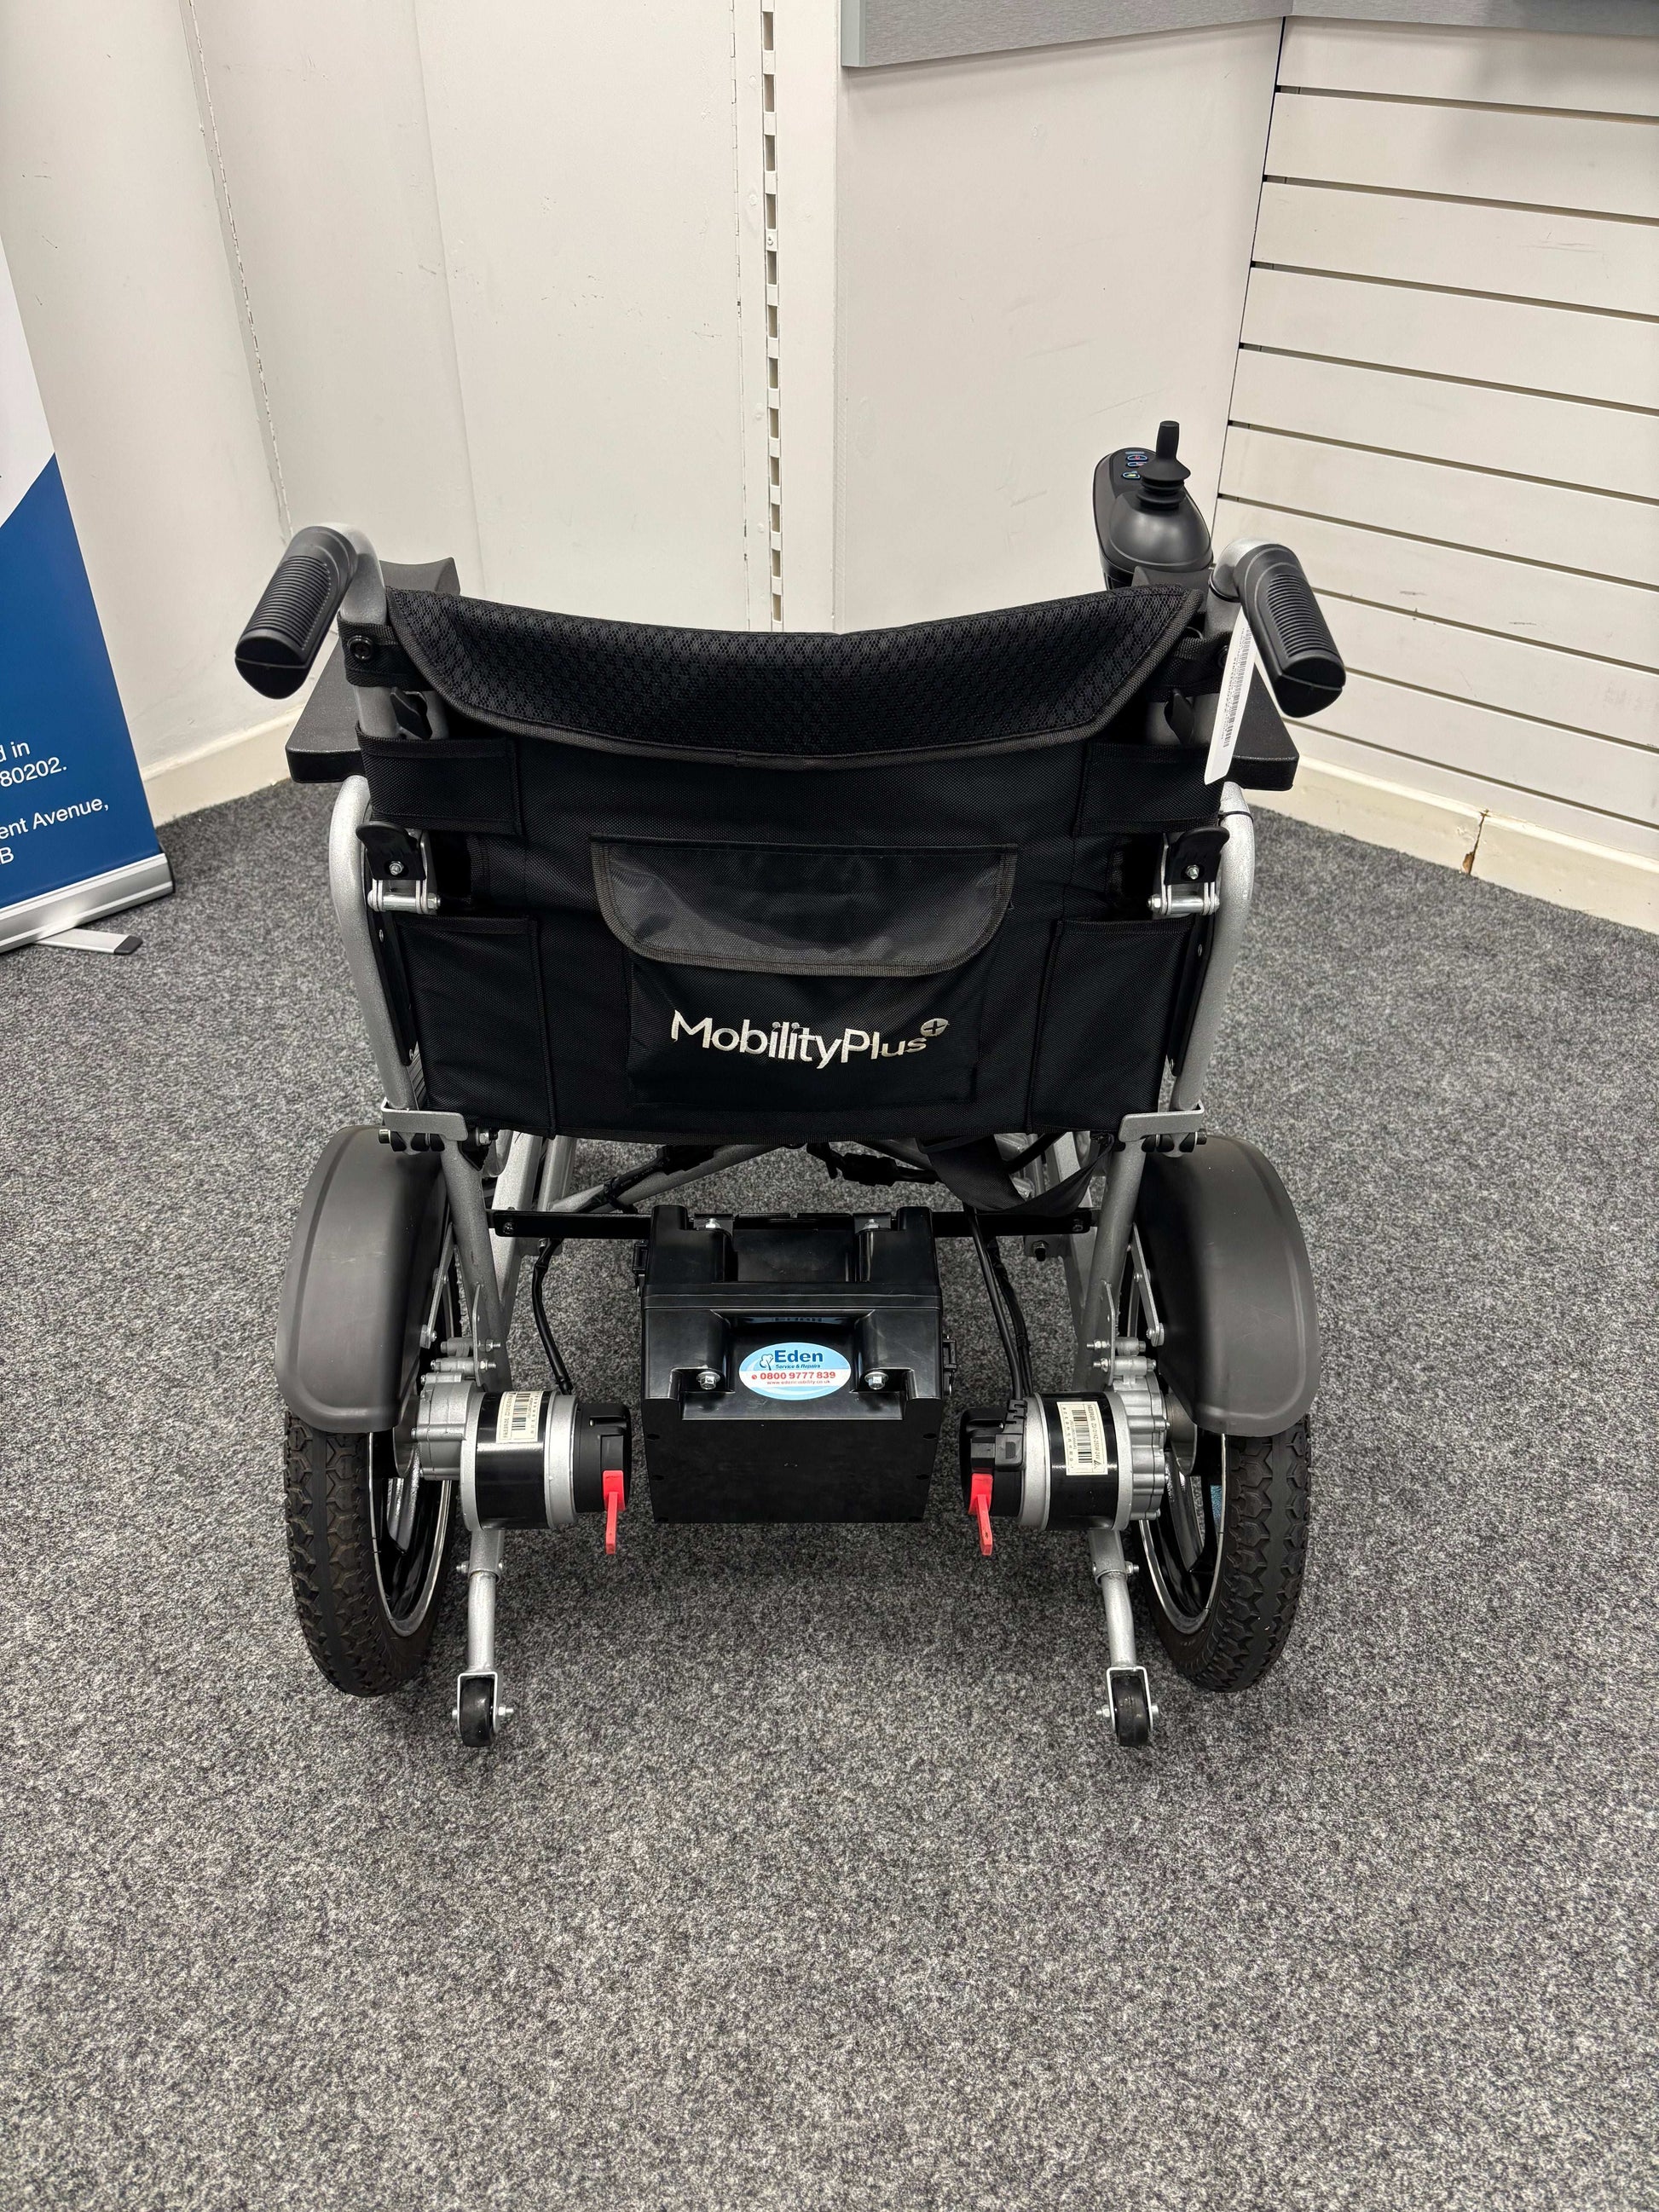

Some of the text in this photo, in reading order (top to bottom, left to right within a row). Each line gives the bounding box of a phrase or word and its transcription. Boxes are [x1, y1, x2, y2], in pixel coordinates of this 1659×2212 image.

[10, 741, 31, 758] in
[0, 757, 67, 788] 80202.
[0, 797, 110, 840] ent Avenue,
[671, 1009, 929, 1070] MobilityPlus
[774, 1349, 824, 1363] Eden
[789, 1372, 815, 1380] 9777
[816, 1371, 836, 1379] 839
